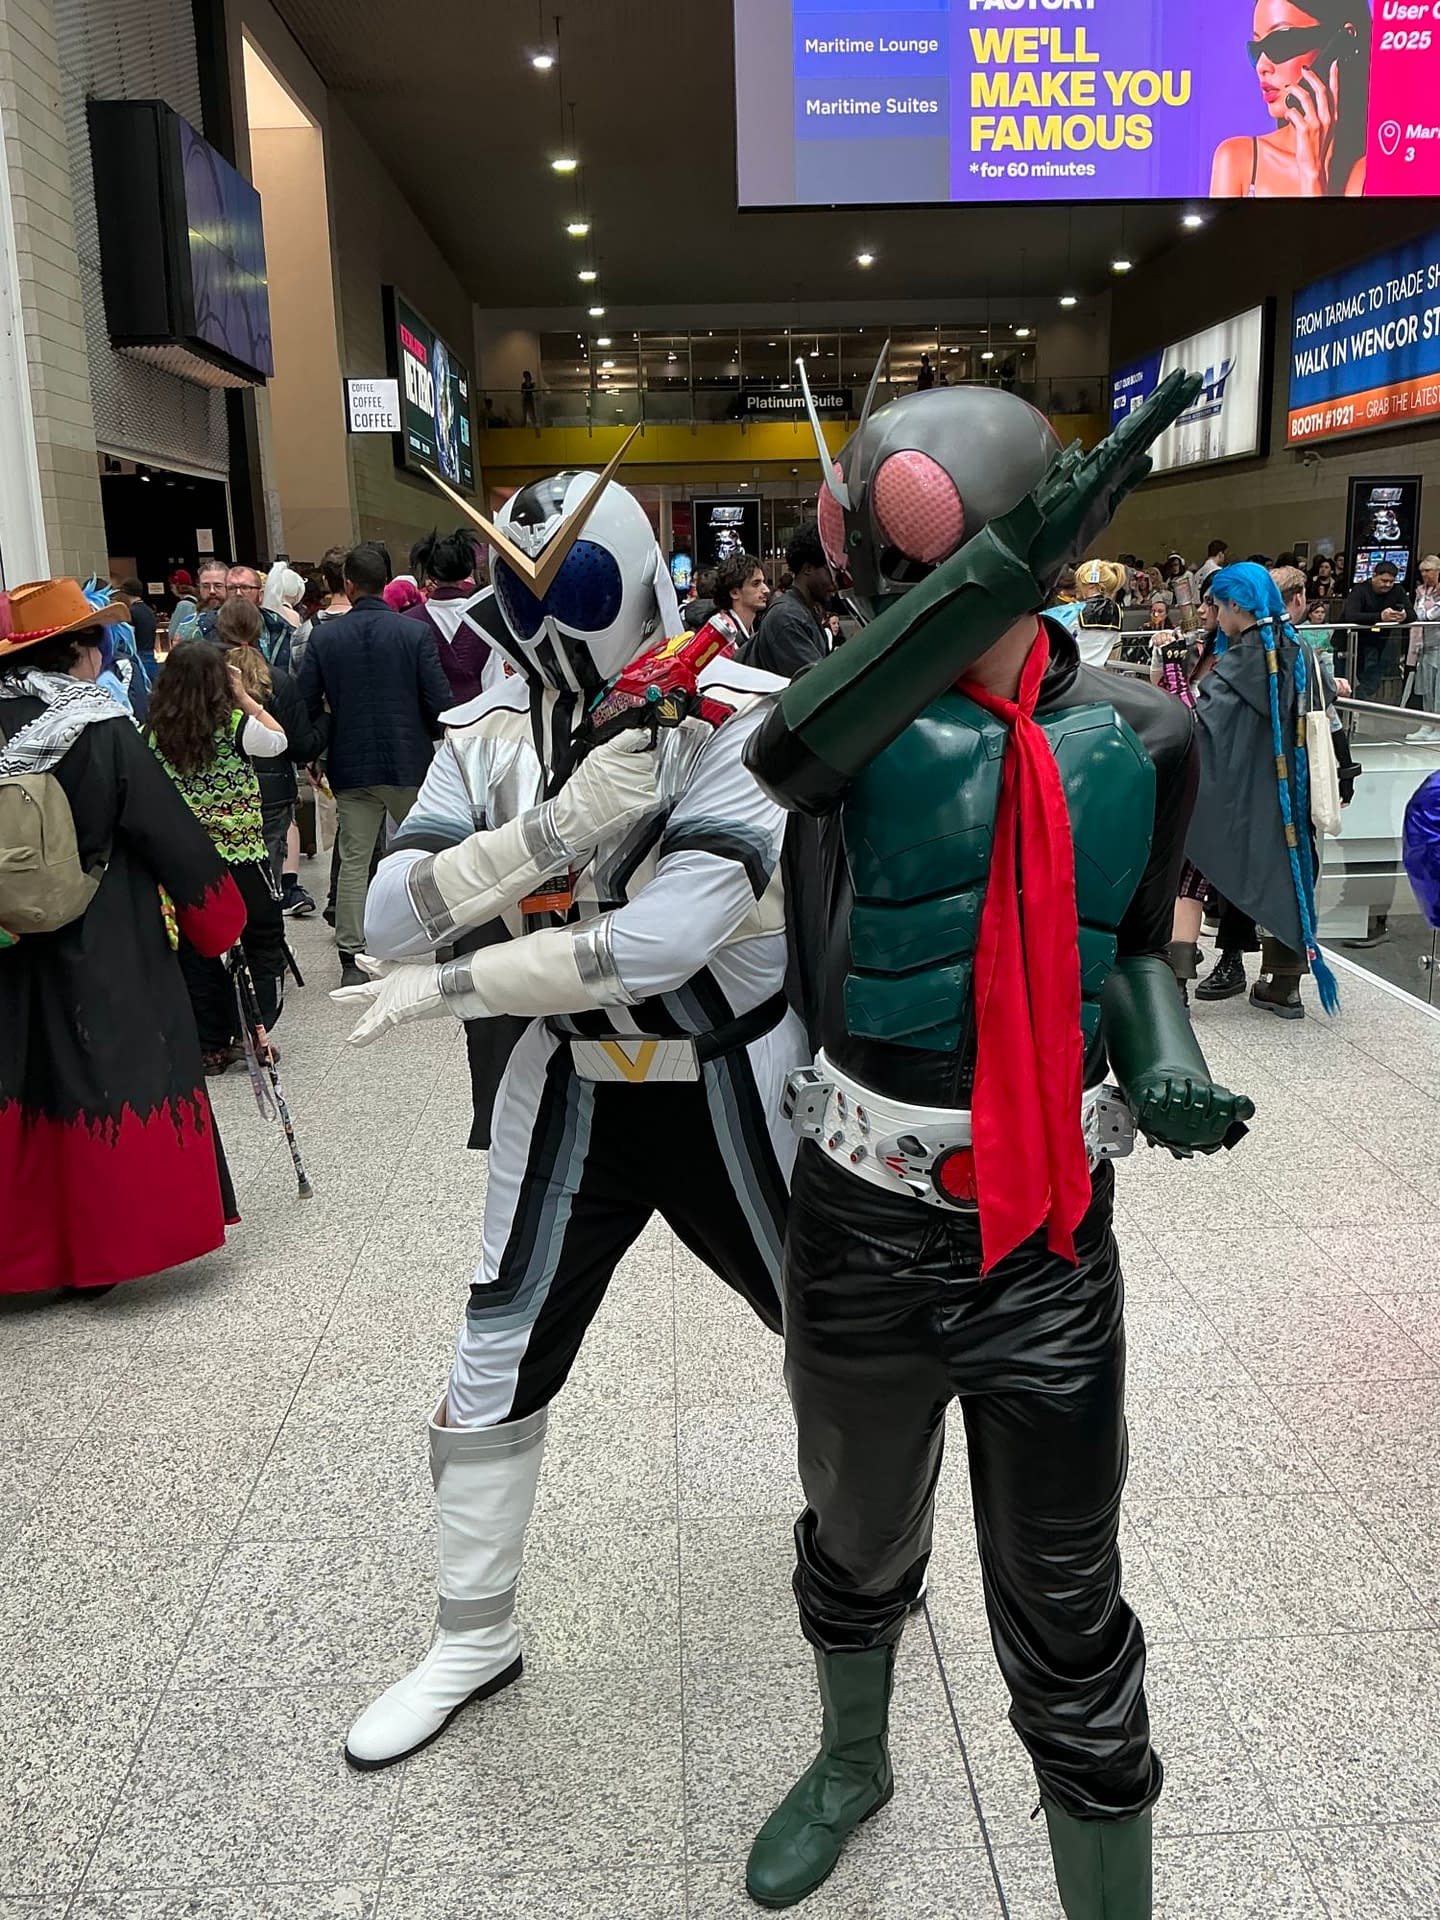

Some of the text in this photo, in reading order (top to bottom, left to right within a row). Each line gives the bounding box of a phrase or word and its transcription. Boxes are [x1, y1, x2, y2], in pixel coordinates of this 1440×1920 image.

[1382, 1, 1429, 20] User
[805, 38, 938, 54] Maritime Lounge
[969, 27, 1099, 63] WE'LL
[1380, 31, 1432, 49] 2025
[971, 70, 1191, 107] MAKE YOU
[806, 97, 938, 115] Maritime Suites
[971, 114, 1153, 151] FAMOUS
[1404, 147, 1416, 162] 3
[1007, 162, 1028, 177] 60
[1031, 161, 1096, 177] minutes
[1295, 310, 1323, 338] FROM
[1325, 292, 1366, 327] TARMAC
[1368, 286, 1383, 311] TO
[1386, 269, 1424, 305] TRADE
[1294, 344, 1330, 379] WALK
[1332, 338, 1348, 367] IN
[1351, 314, 1418, 361] WENCOR
[746, 394, 844, 409] Platinum Suite
[1291, 414, 1323, 436] BOOTH
[1325, 403, 1354, 429] #1921
[1366, 396, 1390, 418] GRAB
[1392, 392, 1408, 413] THE
